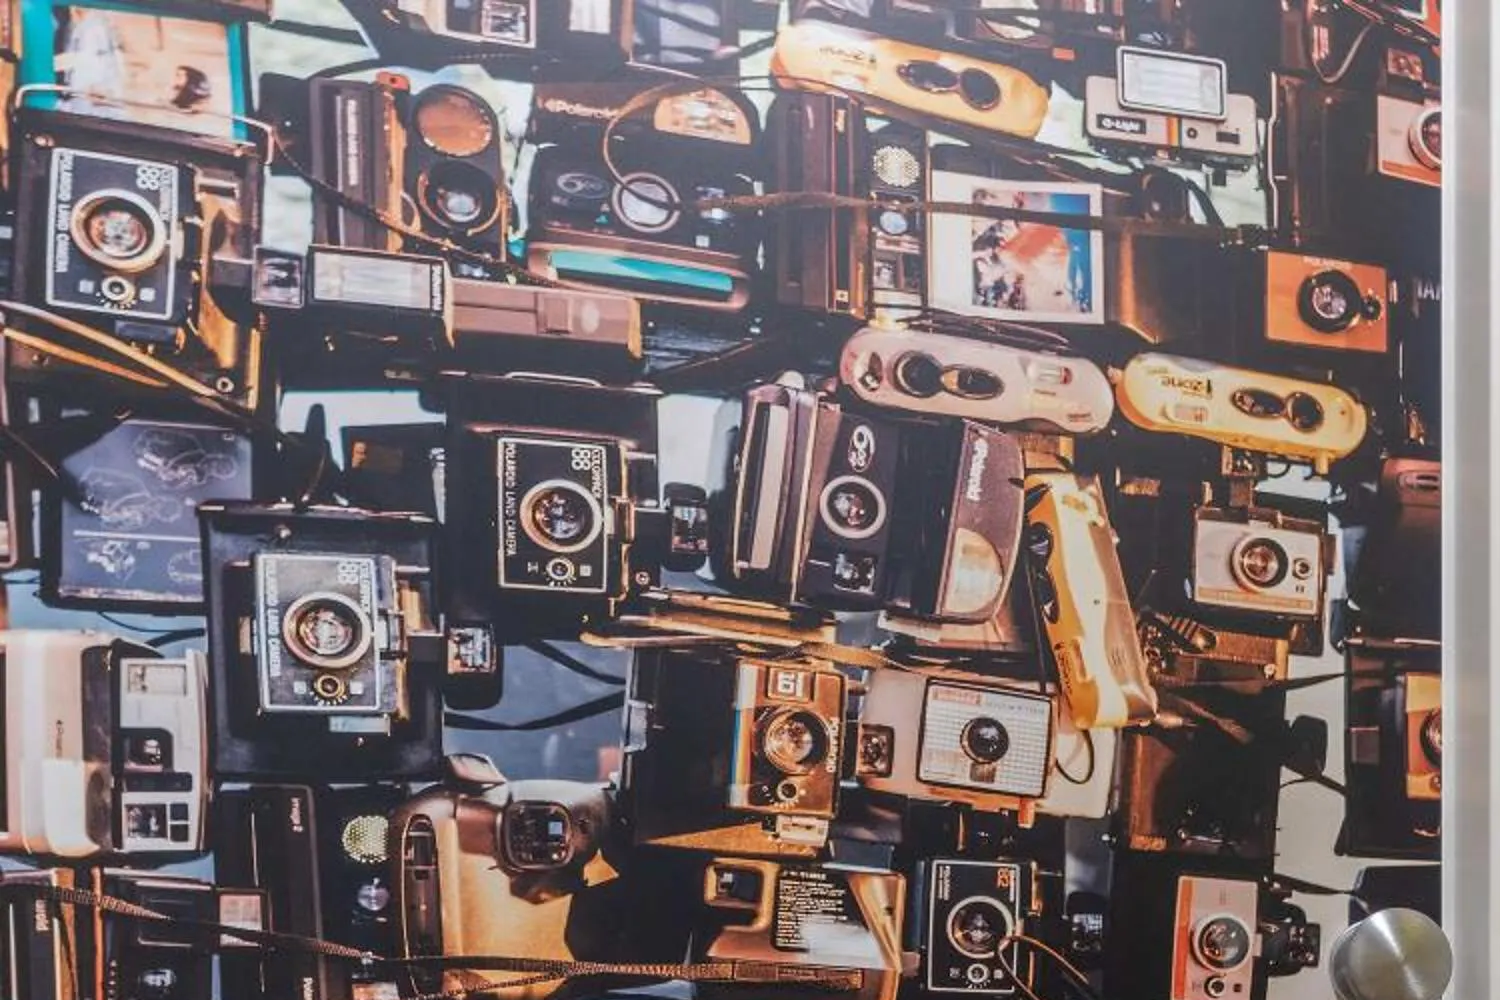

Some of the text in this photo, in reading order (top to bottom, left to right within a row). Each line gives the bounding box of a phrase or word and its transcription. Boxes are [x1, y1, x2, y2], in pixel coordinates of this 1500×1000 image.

[136, 166, 160, 190] 88
[571, 448, 591, 471] 88
[505, 491, 516, 516] LAND
[505, 519, 517, 556] CAMERA
